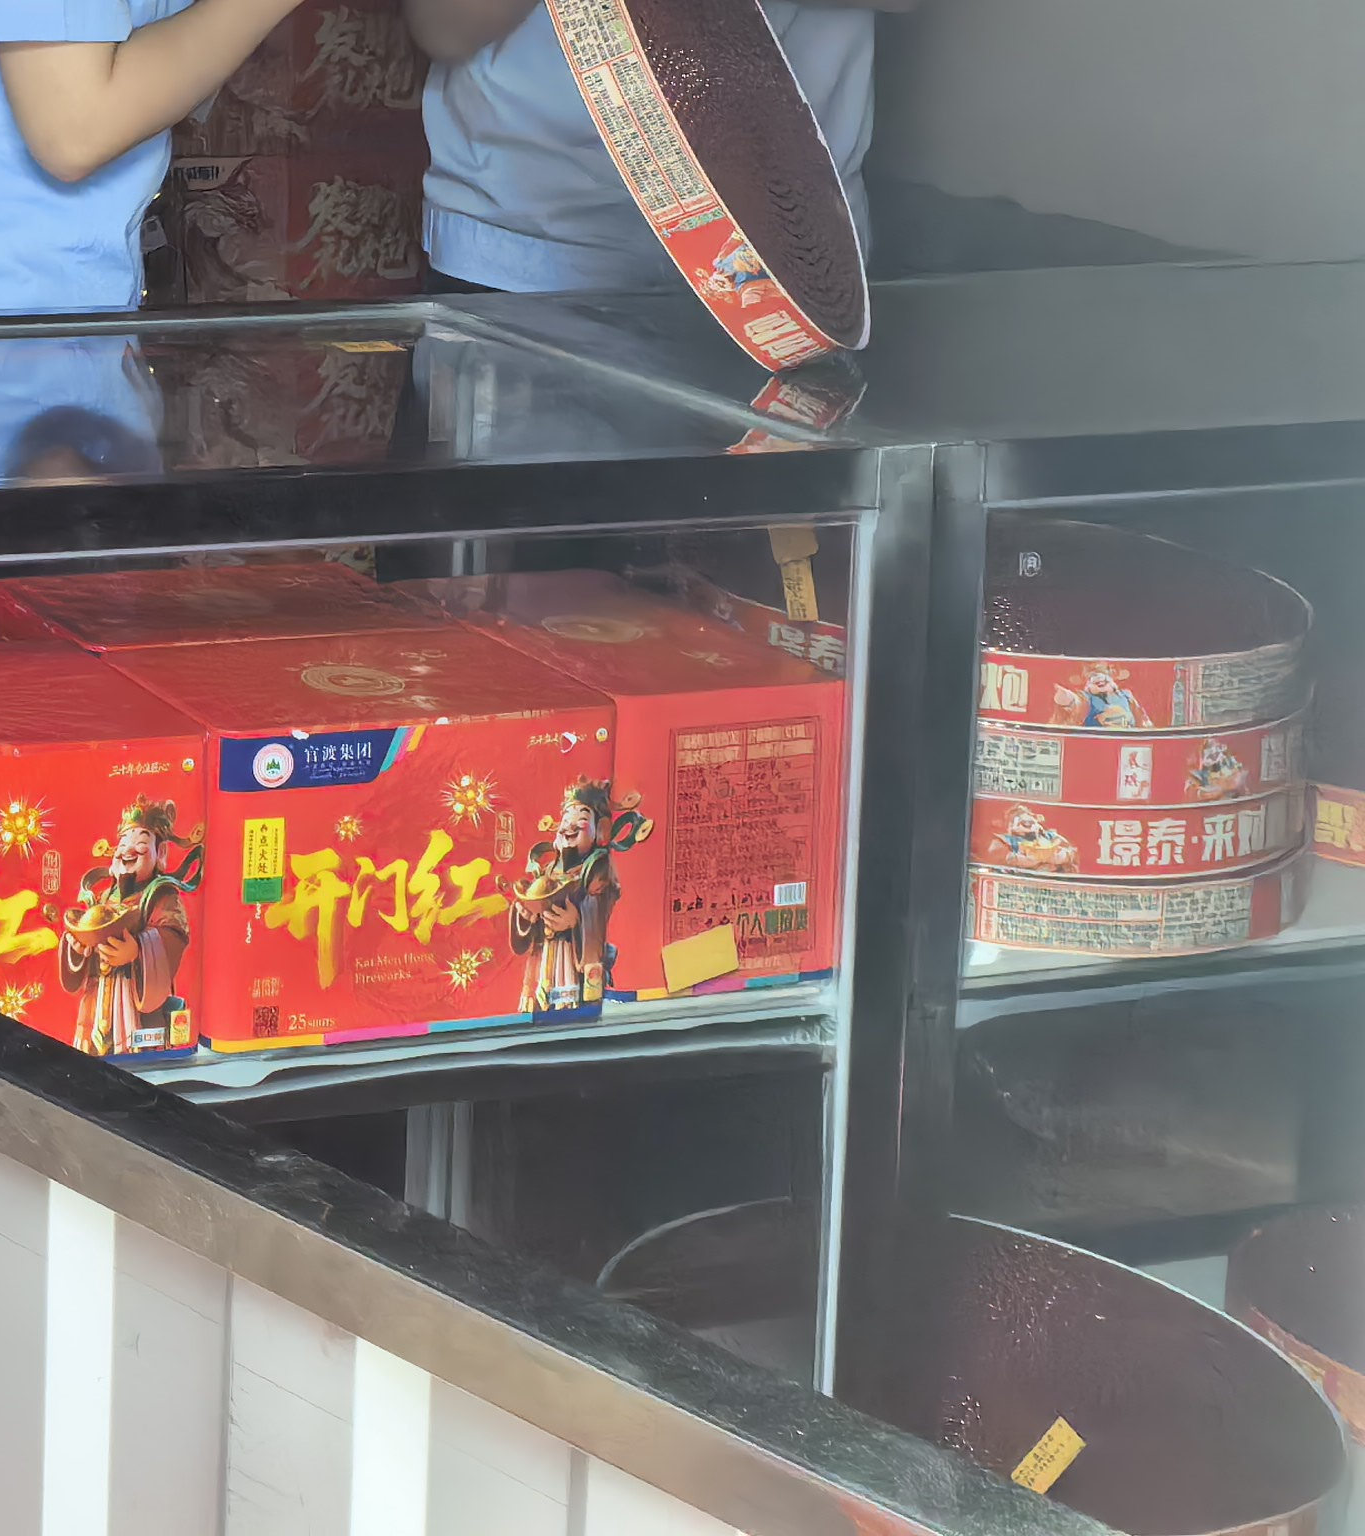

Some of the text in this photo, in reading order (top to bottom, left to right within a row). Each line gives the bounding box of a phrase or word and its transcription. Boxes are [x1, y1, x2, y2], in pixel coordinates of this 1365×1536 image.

[304, 742, 371, 763] 官渡集团
[265, 829, 510, 989] 开门红
[355, 969, 412, 984] Fireworks
